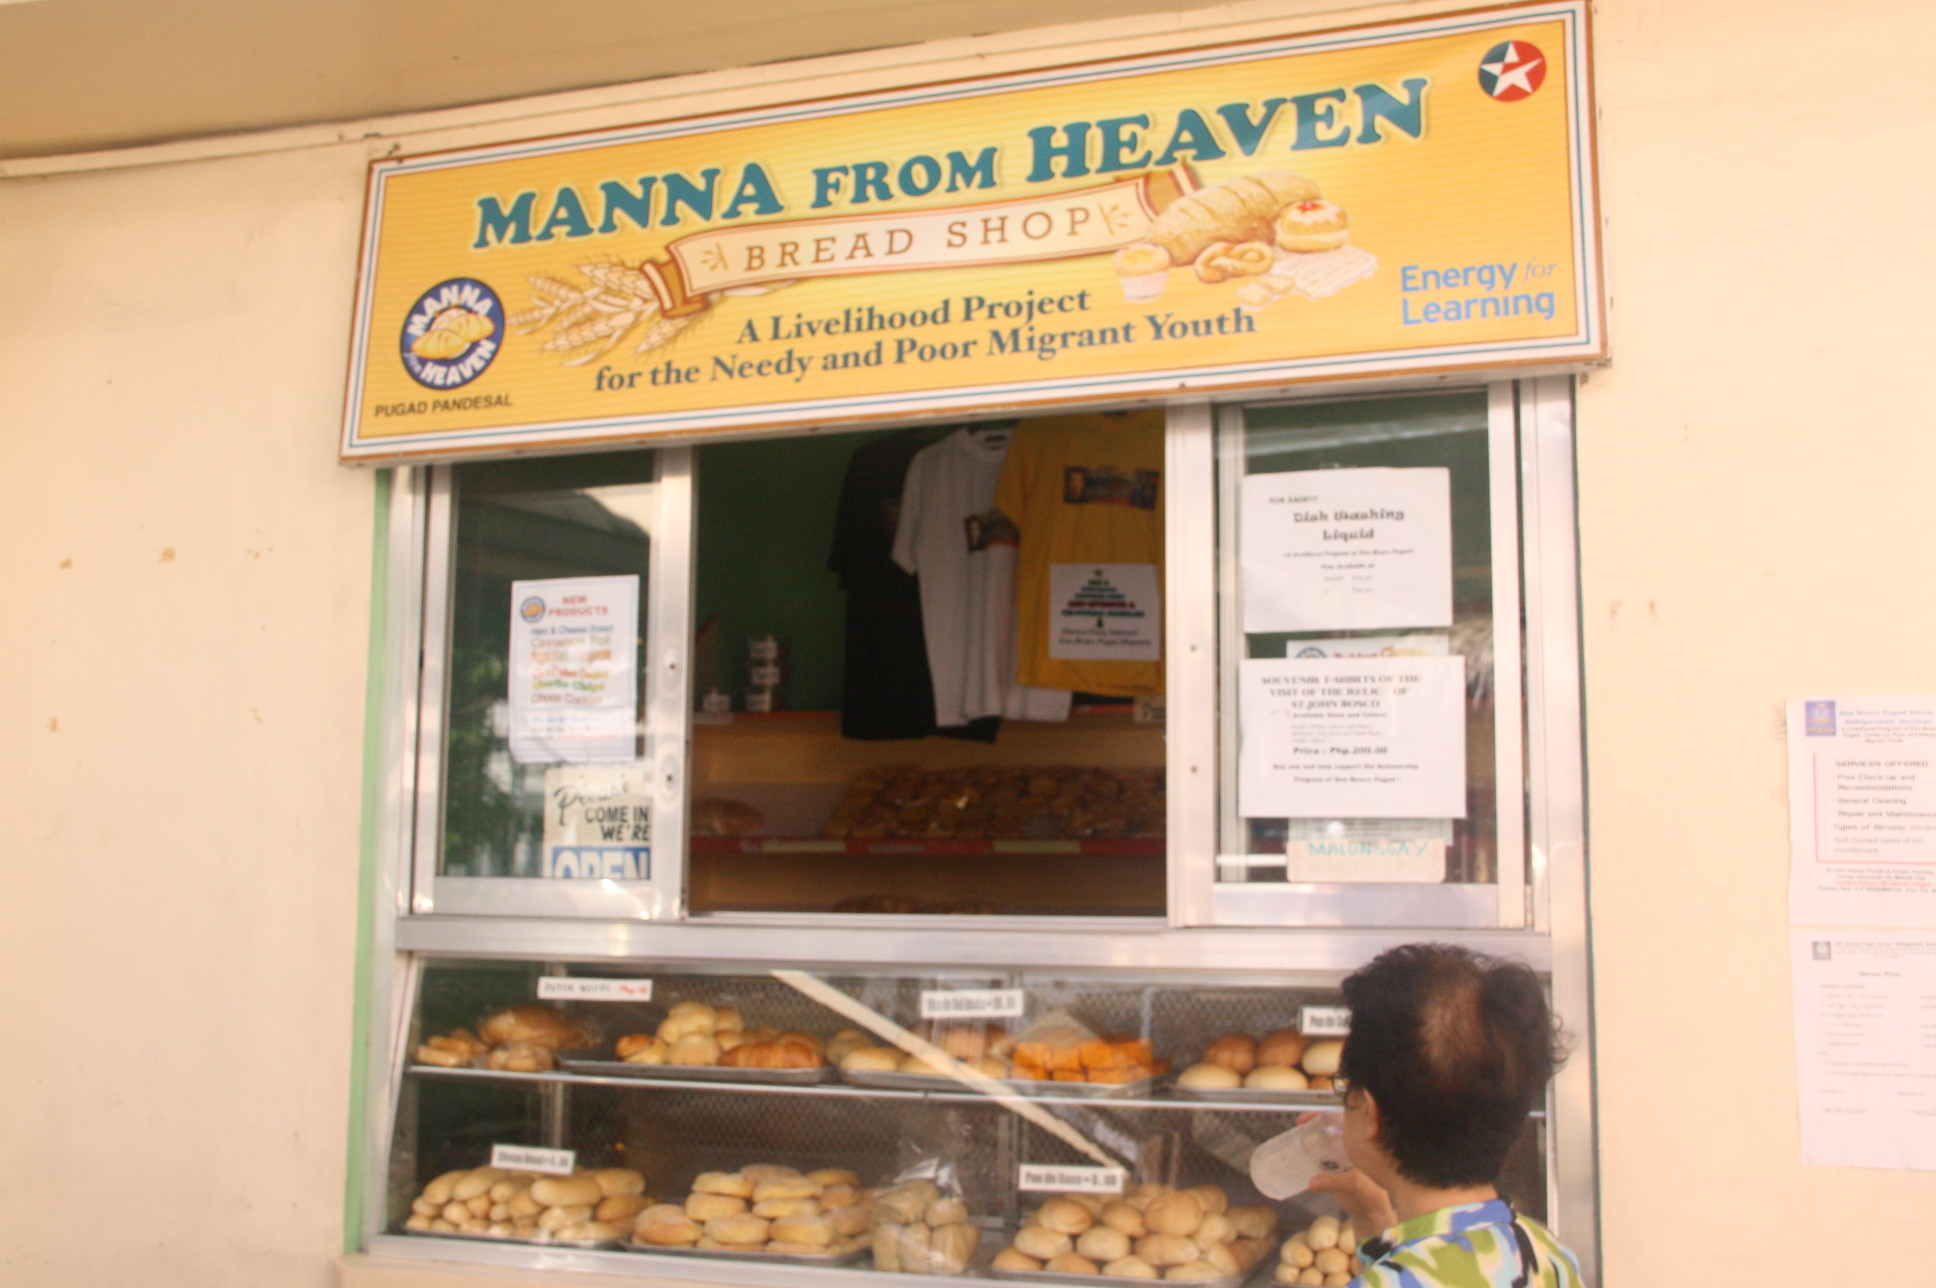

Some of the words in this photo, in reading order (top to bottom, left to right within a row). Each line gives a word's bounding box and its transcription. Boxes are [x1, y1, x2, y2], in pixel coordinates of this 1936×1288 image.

[472, 162, 785, 249] MANNA
[811, 146, 999, 209] FROM
[1027, 78, 1429, 182] HEAVEN
[745, 229, 913, 272] BREAD
[946, 207, 1091, 249] SHOP
[1400, 262, 1518, 292] Energy
[1520, 257, 1557, 286] for
[407, 284, 494, 337] MANNA
[736, 319, 759, 344] A
[770, 301, 950, 341] Livelihood
[963, 289, 1090, 326] Project
[1402, 291, 1555, 326] Learning
[595, 366, 642, 393] for
[649, 360, 700, 387] the
[711, 349, 809, 383] Needy
[821, 344, 884, 372] and
[895, 338, 978, 365] Poor
[987, 320, 1137, 360] Migrant
[1144, 306, 1256, 342] Youth
[419, 338, 498, 387] HEAVEN
[374, 401, 427, 419] PUGAD
[432, 394, 512, 413] PANDESAL
[1293, 510, 1329, 522] Dish
[1333, 507, 1405, 523] Washing
[1322, 527, 1376, 543] Liquid
[561, 595, 588, 604] NEW
[547, 606, 609, 617] PRODUCTS
[1261, 675, 1320, 684] SOUVENIR
[1301, 688, 1317, 696] OF
[1320, 687, 1342, 696] THE
[1340, 699, 1382, 708] BOSCO
[1292, 745, 1320, 755] Price
[584, 805, 629, 823] COME
[632, 804, 649, 823] IN
[600, 823, 651, 842] WE'RE
